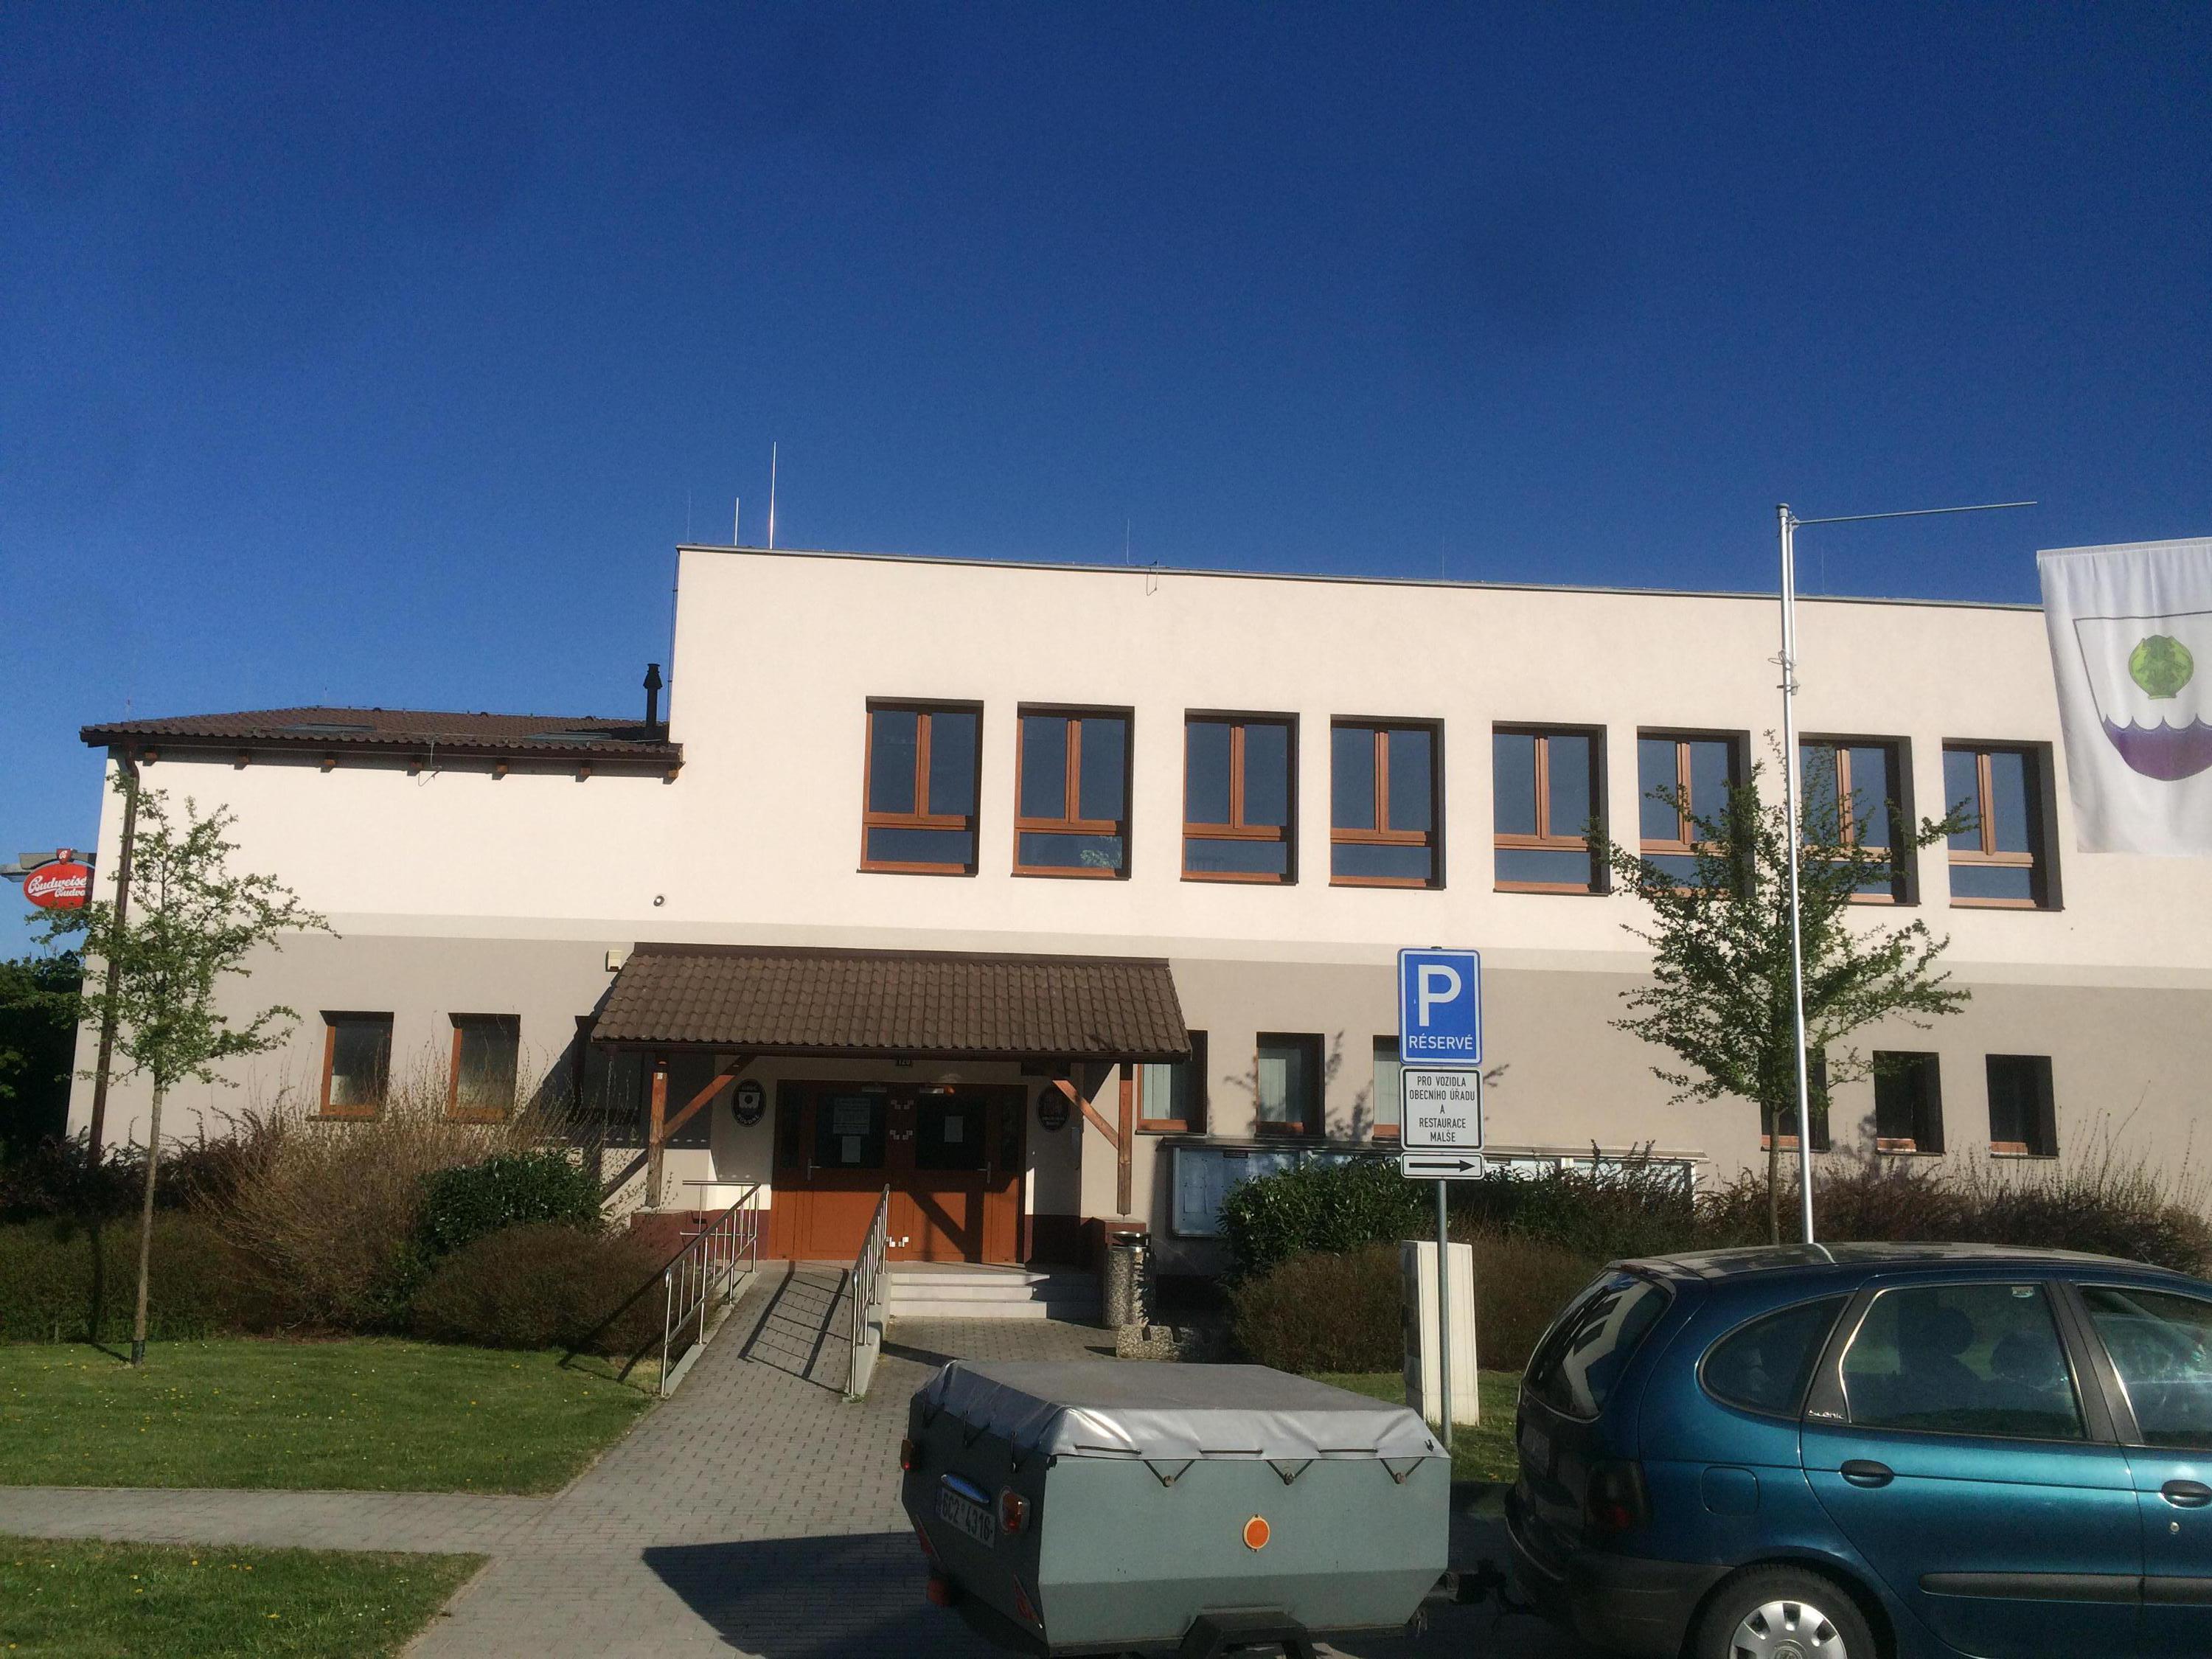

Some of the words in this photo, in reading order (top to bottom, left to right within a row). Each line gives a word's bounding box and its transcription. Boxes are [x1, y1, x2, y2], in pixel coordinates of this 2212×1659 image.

[28, 875, 88, 894] Budweise
[1418, 964, 1461, 1026] P
[1409, 1033, 1473, 1050] RÉSERVÉ
[1417, 1077, 1432, 1086] PRO
[1436, 1077, 1467, 1087] VOZIDLA
[1409, 1088, 1446, 1100] OBECNÍHO
[1450, 1088, 1475, 1101] ÚŘADU
[1440, 1105, 1445, 1113] A
[1419, 1118, 1467, 1128] RESTAURACE
[1430, 1129, 1455, 1142] MALŠE
